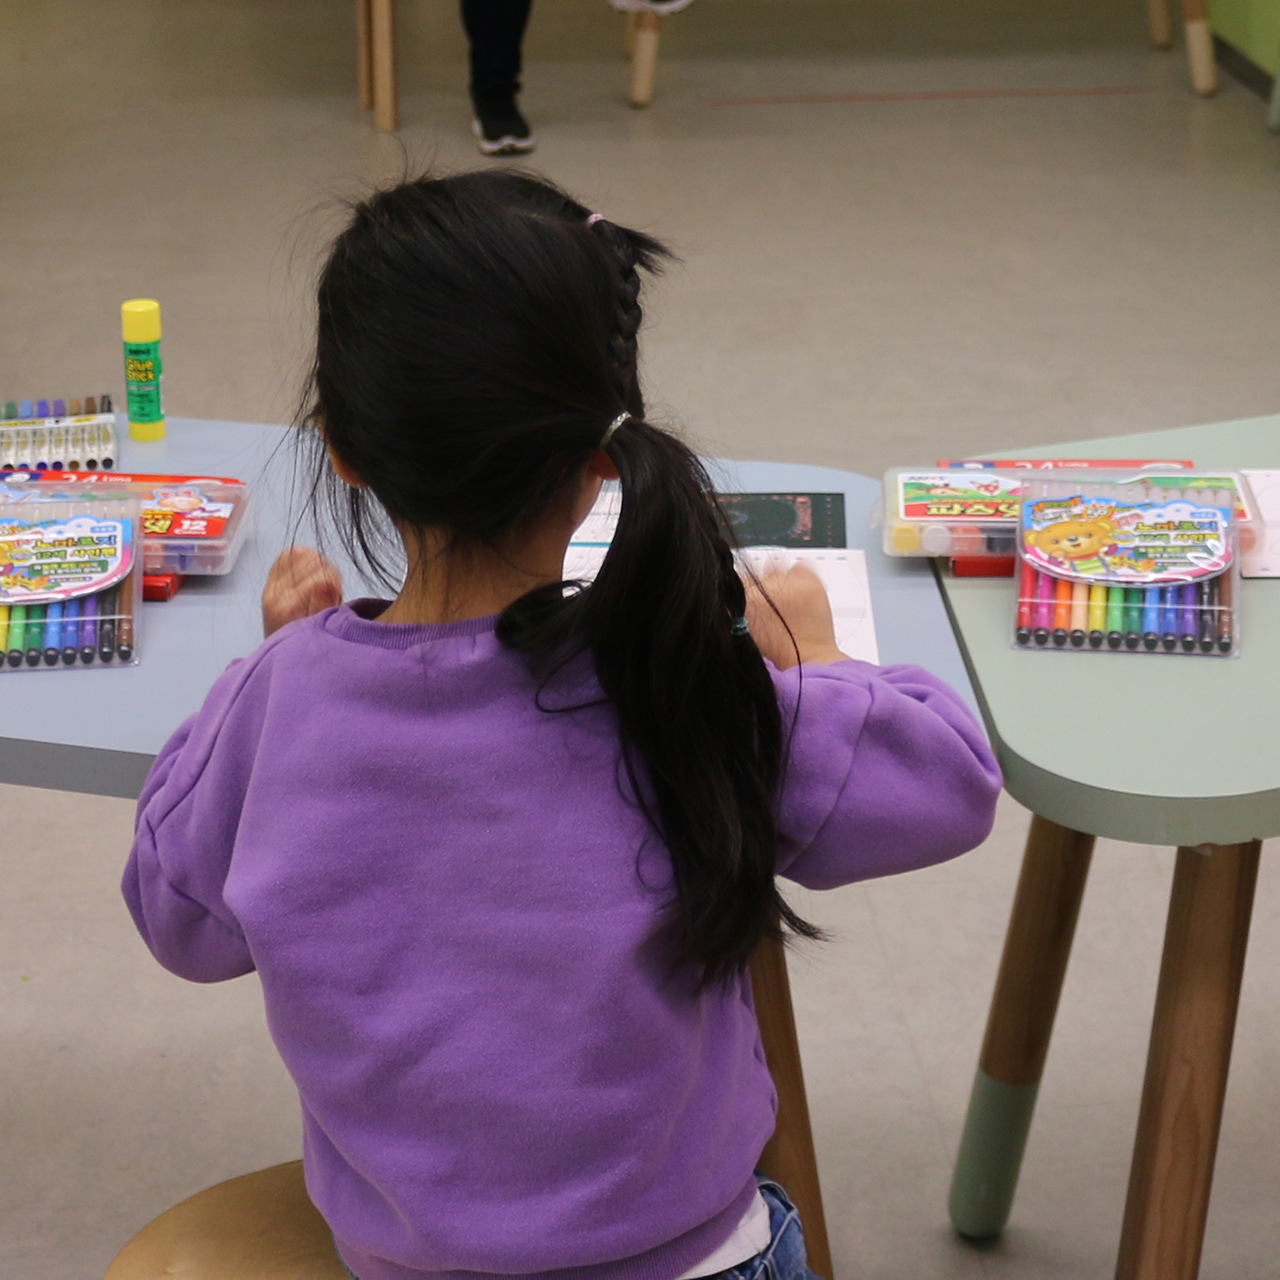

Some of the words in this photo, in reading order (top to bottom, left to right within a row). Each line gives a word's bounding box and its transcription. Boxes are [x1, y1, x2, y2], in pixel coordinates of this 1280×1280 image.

[126, 358, 154, 371] Glue
[126, 370, 155, 381] Stick
[181, 520, 208, 531] 12
[70, 547, 116, 559] 사인펜
